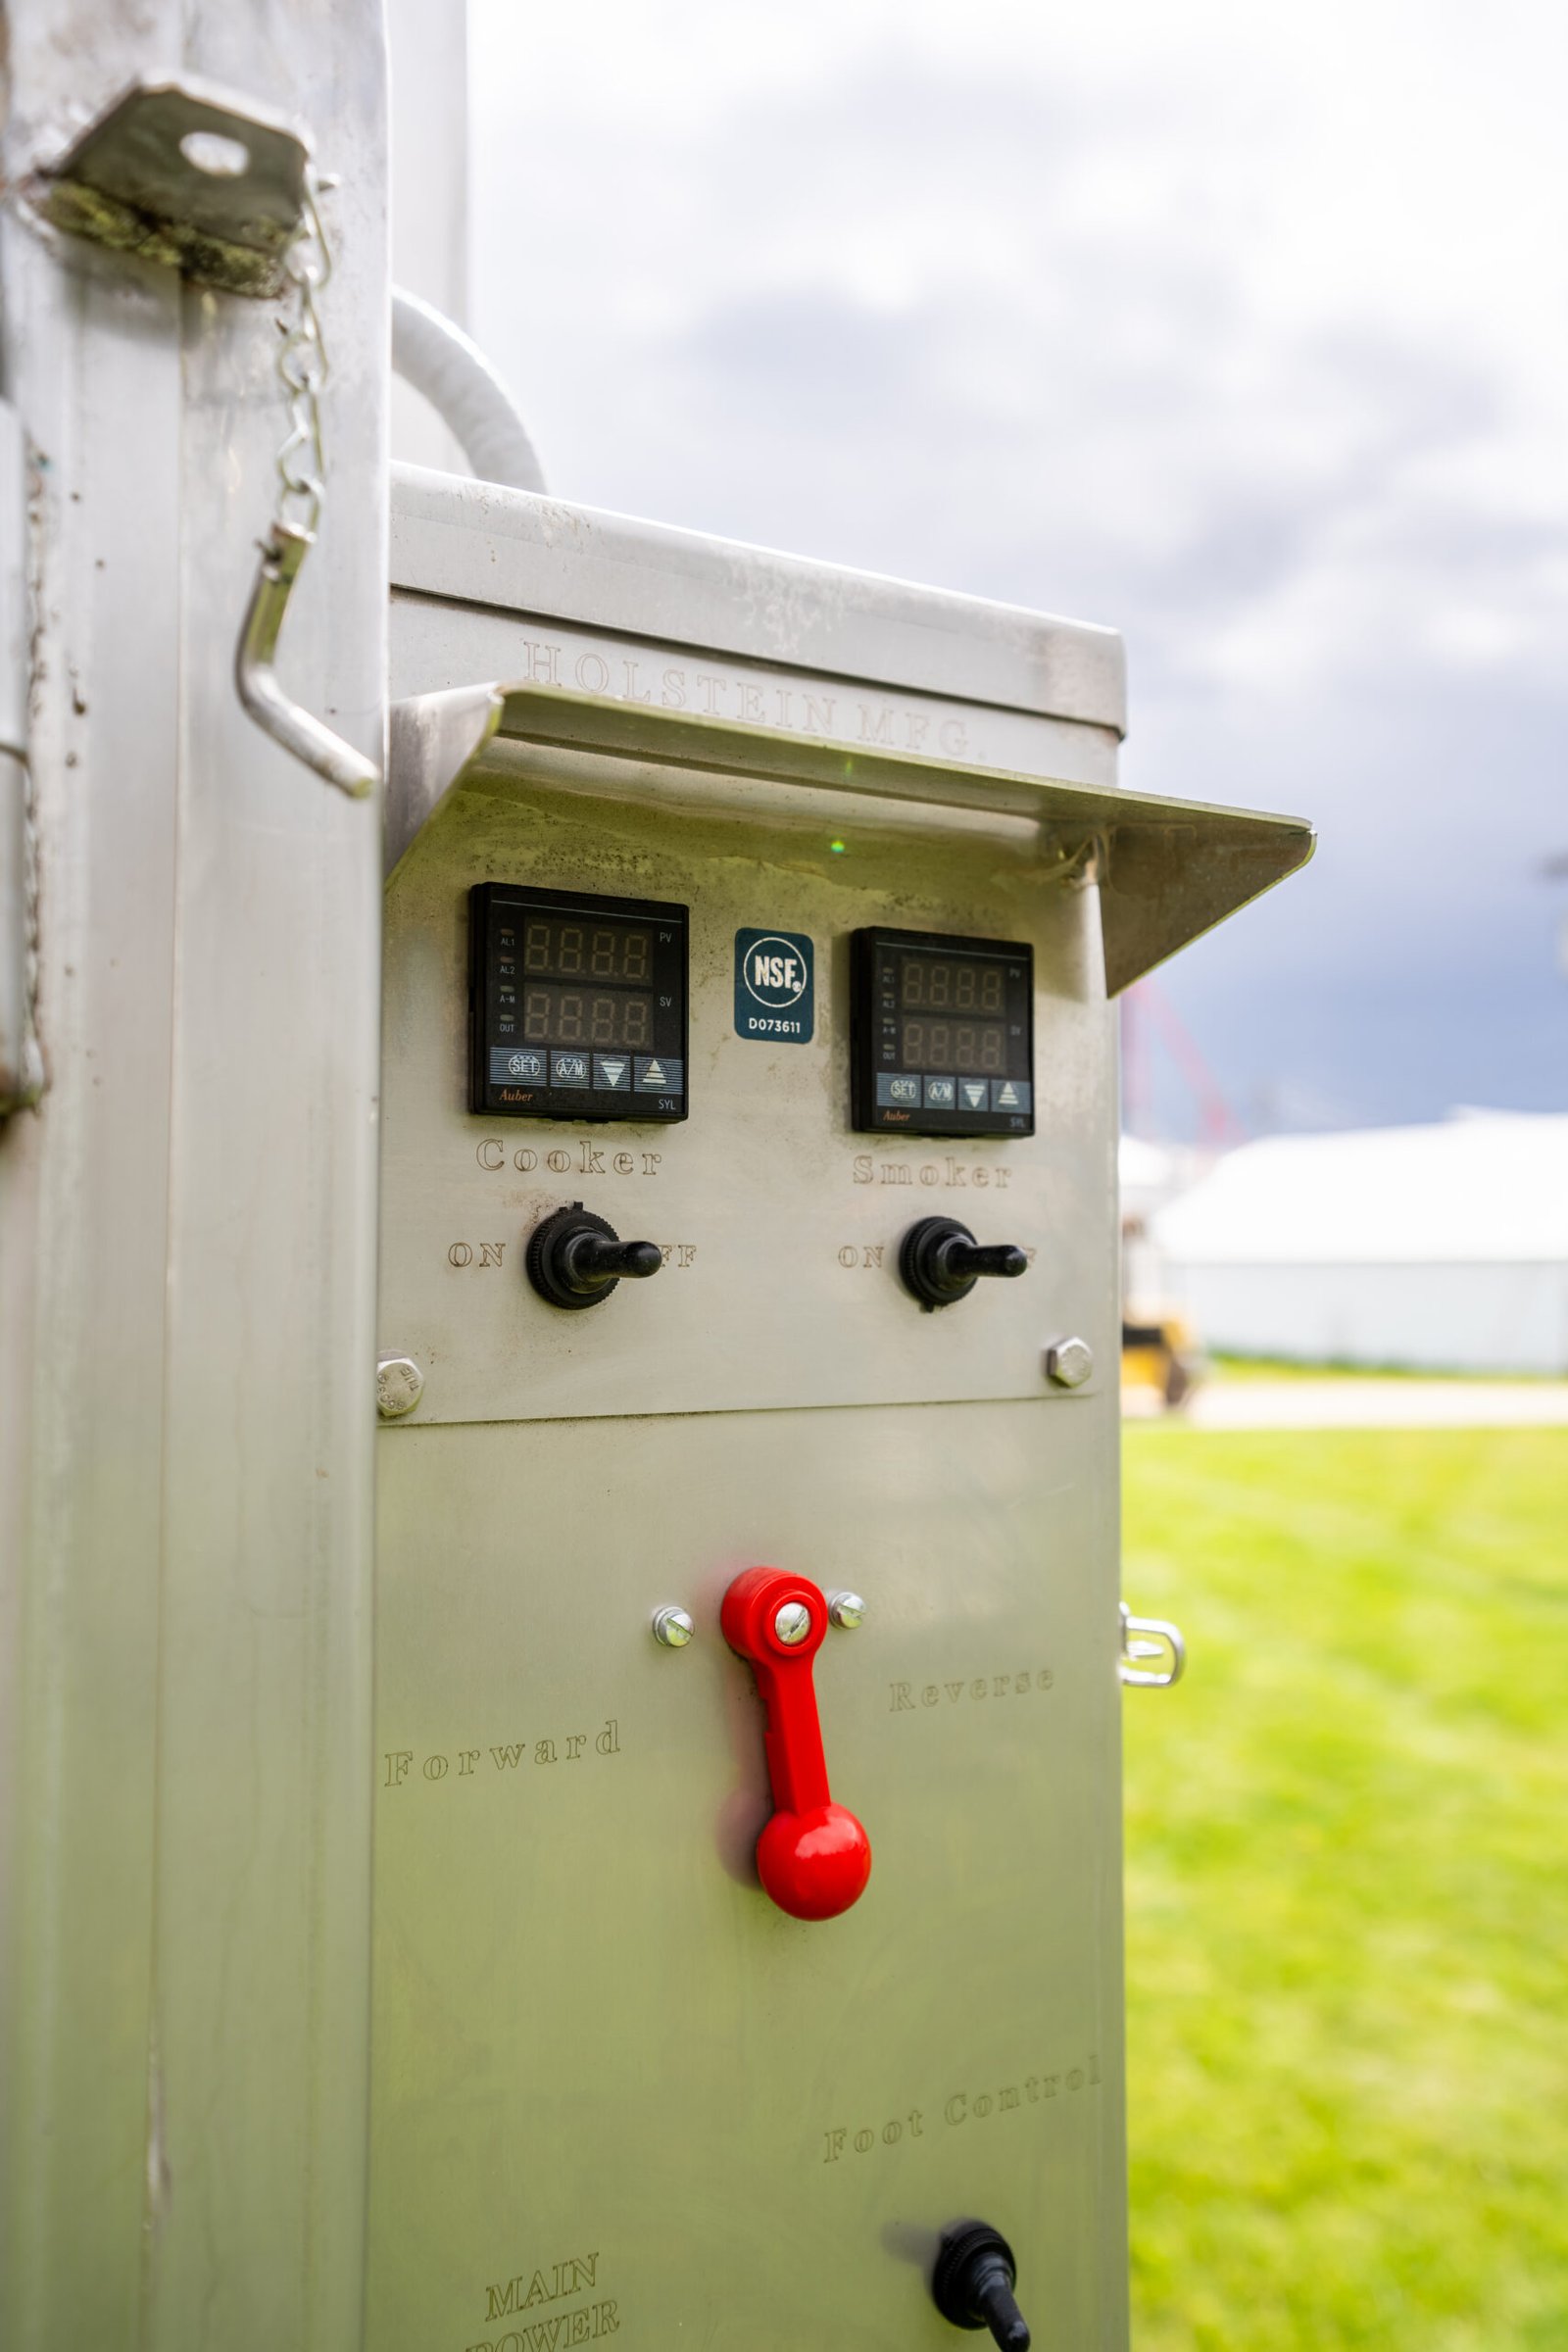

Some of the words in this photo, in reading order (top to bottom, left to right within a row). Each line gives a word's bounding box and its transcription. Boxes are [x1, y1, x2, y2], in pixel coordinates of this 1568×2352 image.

[523, 641, 837, 734] HOLSTEIN
[660, 932, 671, 943] PV
[501, 965, 514, 974] AL2
[755, 955, 798, 989] NSF
[500, 995, 515, 1004] A-M
[660, 997, 671, 1007] SV
[500, 1023, 514, 1033] OUT
[512, 1059, 537, 1074] SET
[559, 1061, 584, 1077] A/M
[499, 1089, 533, 1102] Auber
[893, 1083, 914, 1096] SET
[659, 1100, 676, 1110] SYL
[883, 1110, 910, 1122] Auber
[476, 1138, 662, 1175] Cooker
[853, 1154, 1012, 1188] Smoker
[448, 1242, 506, 1267] ON
[660, 1245, 697, 1267] FF
[838, 1246, 884, 1268] ON
[889, 1669, 1054, 1713] Reverse
[384, 1720, 620, 1787] Forward
[823, 2110, 923, 2163] Foot
[944, 2054, 1102, 2126] Control
[485, 2252, 599, 2322] MAIN
[466, 2299, 619, 2352] OWER
